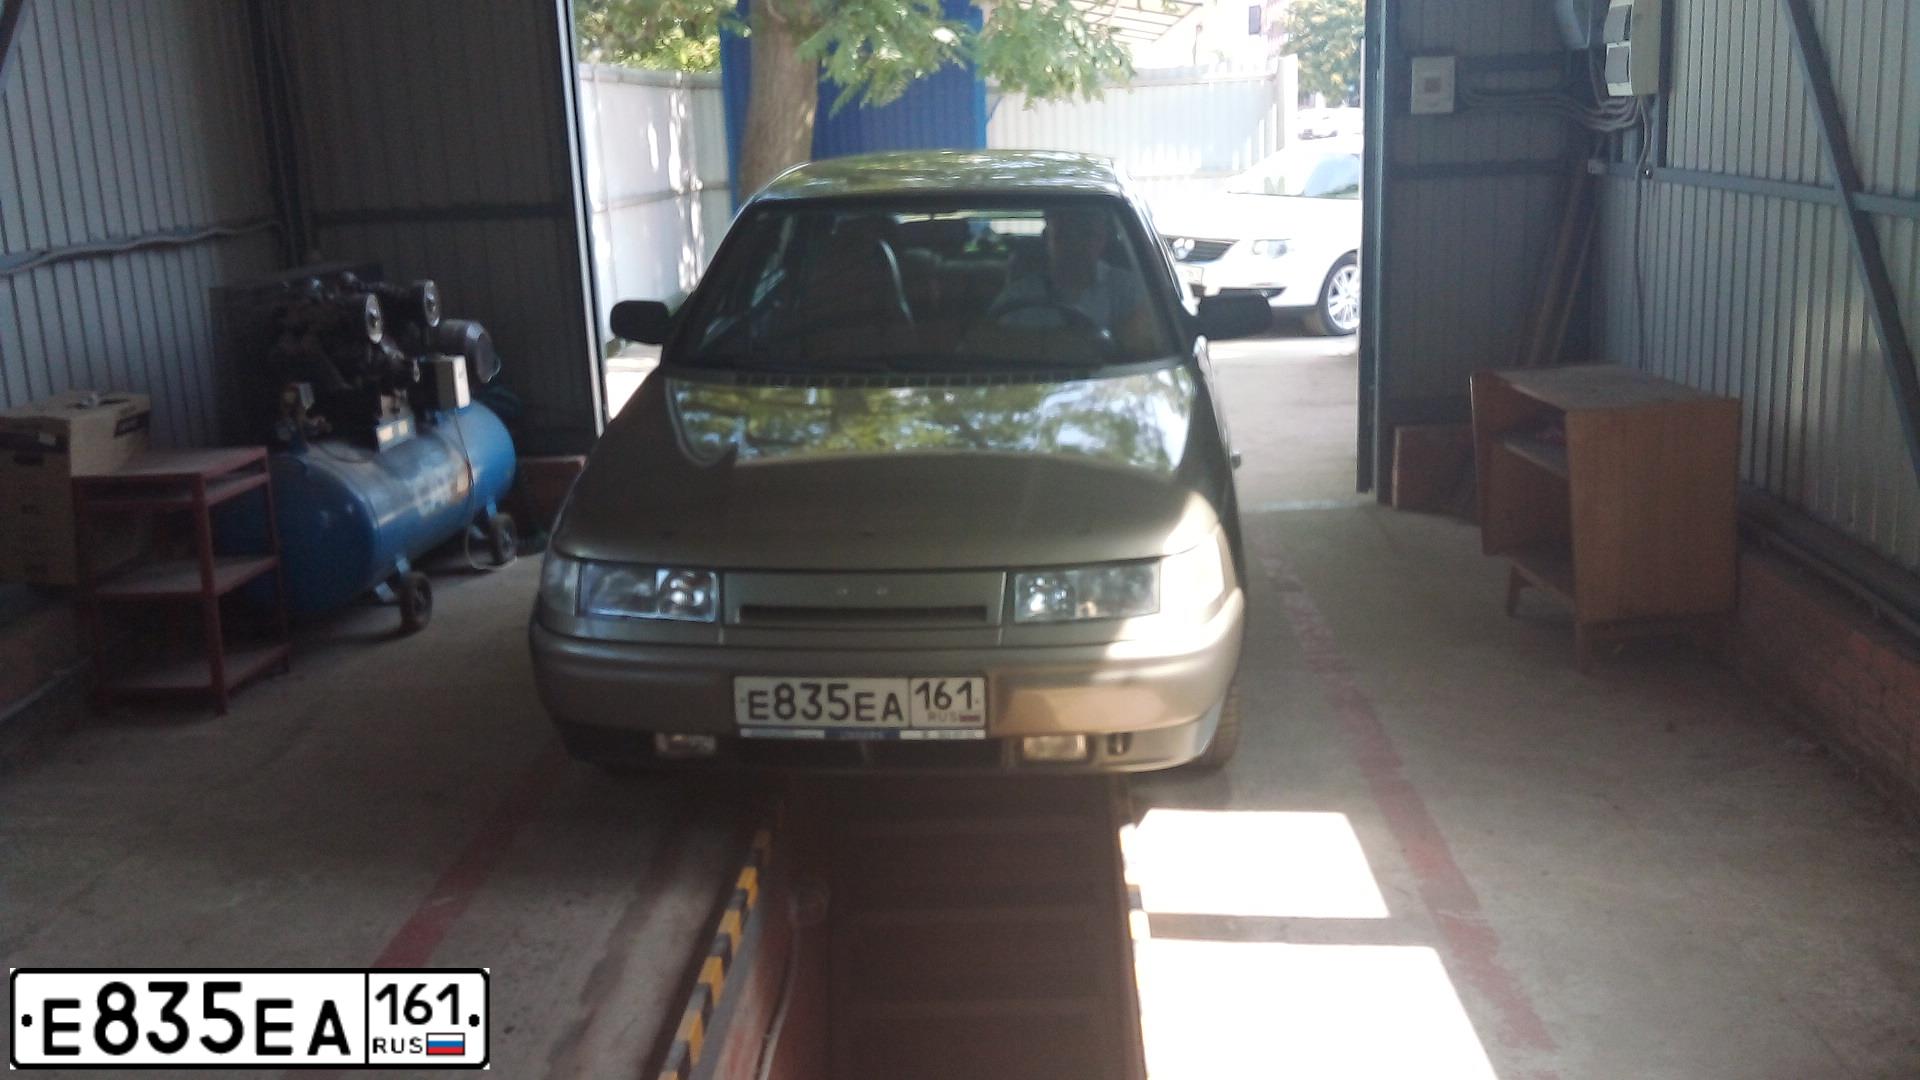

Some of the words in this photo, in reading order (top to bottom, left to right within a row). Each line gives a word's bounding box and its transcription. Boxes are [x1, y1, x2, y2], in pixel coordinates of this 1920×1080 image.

[748, 683, 903, 721] E835EA
[915, 681, 972, 711] 161
[928, 712, 957, 722] RUS
